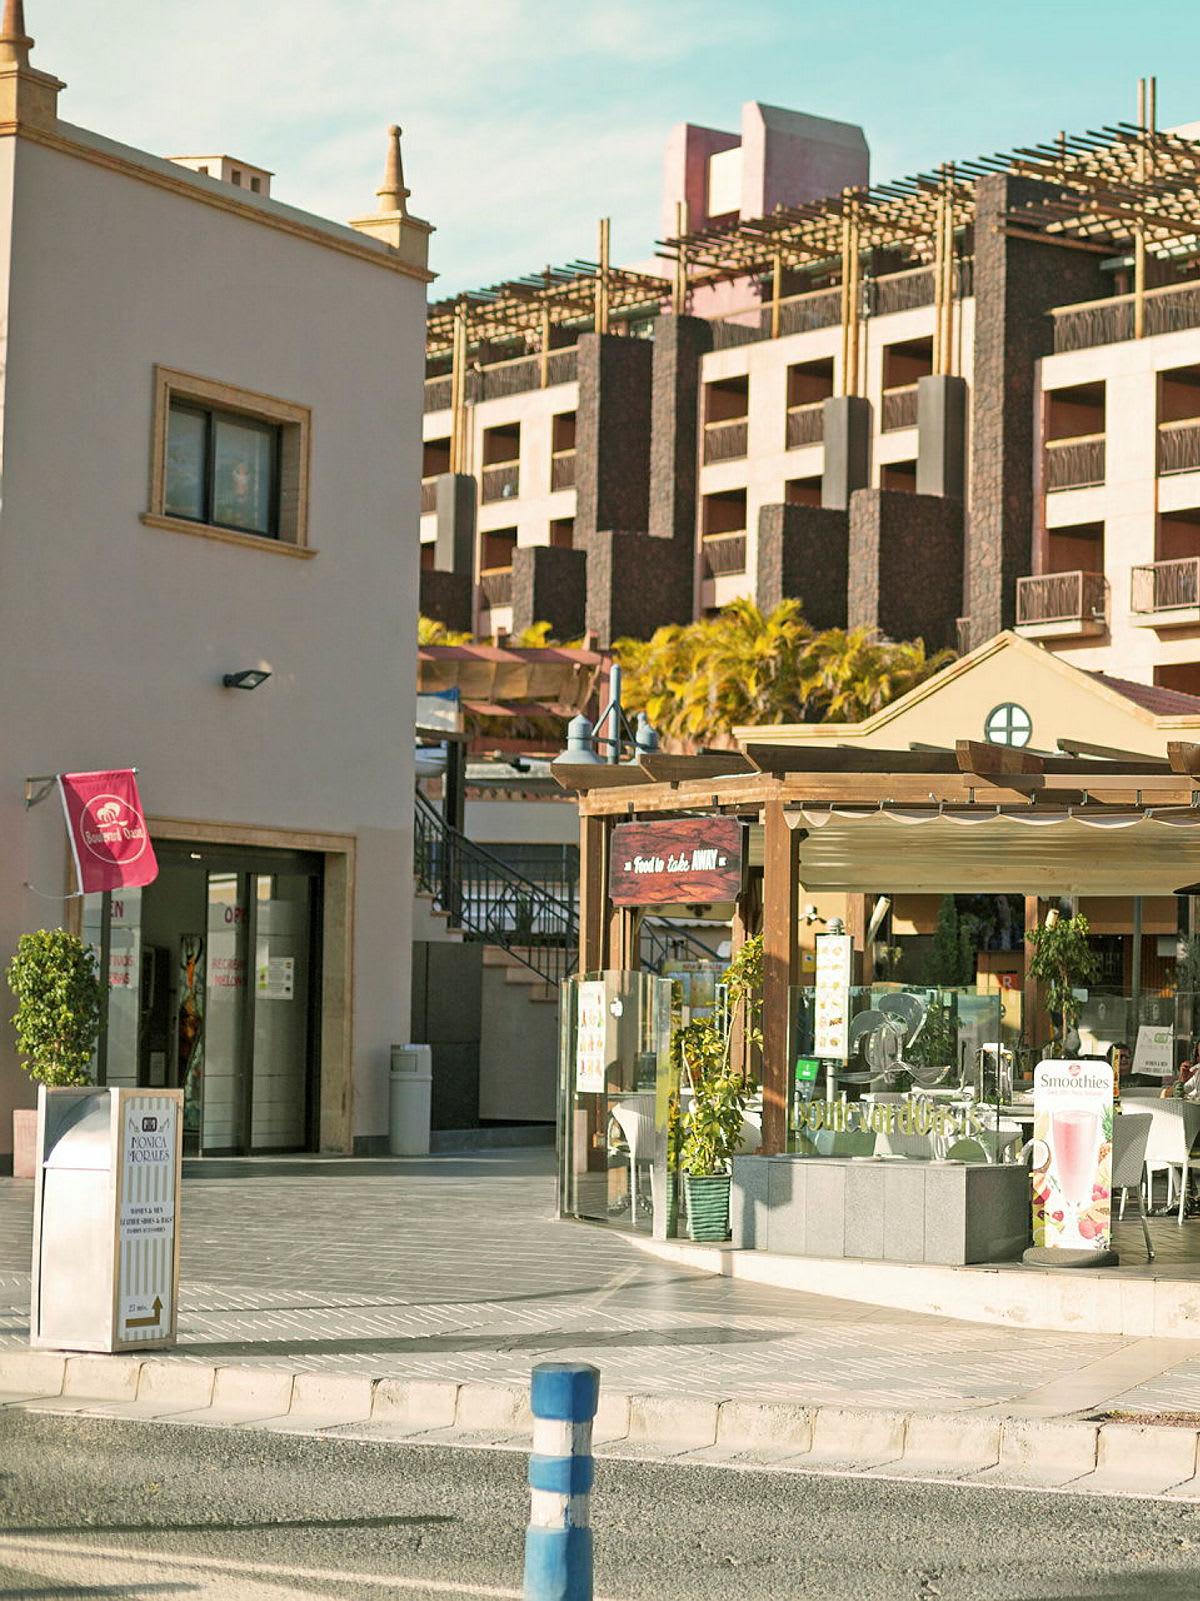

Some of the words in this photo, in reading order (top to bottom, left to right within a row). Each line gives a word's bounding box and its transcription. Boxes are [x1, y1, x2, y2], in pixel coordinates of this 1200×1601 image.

[667, 852, 690, 873] take
[691, 848, 718, 871] AWAY
[1040, 1073, 1109, 1089] Smoothies
[127, 1150, 170, 1162] MORALES
